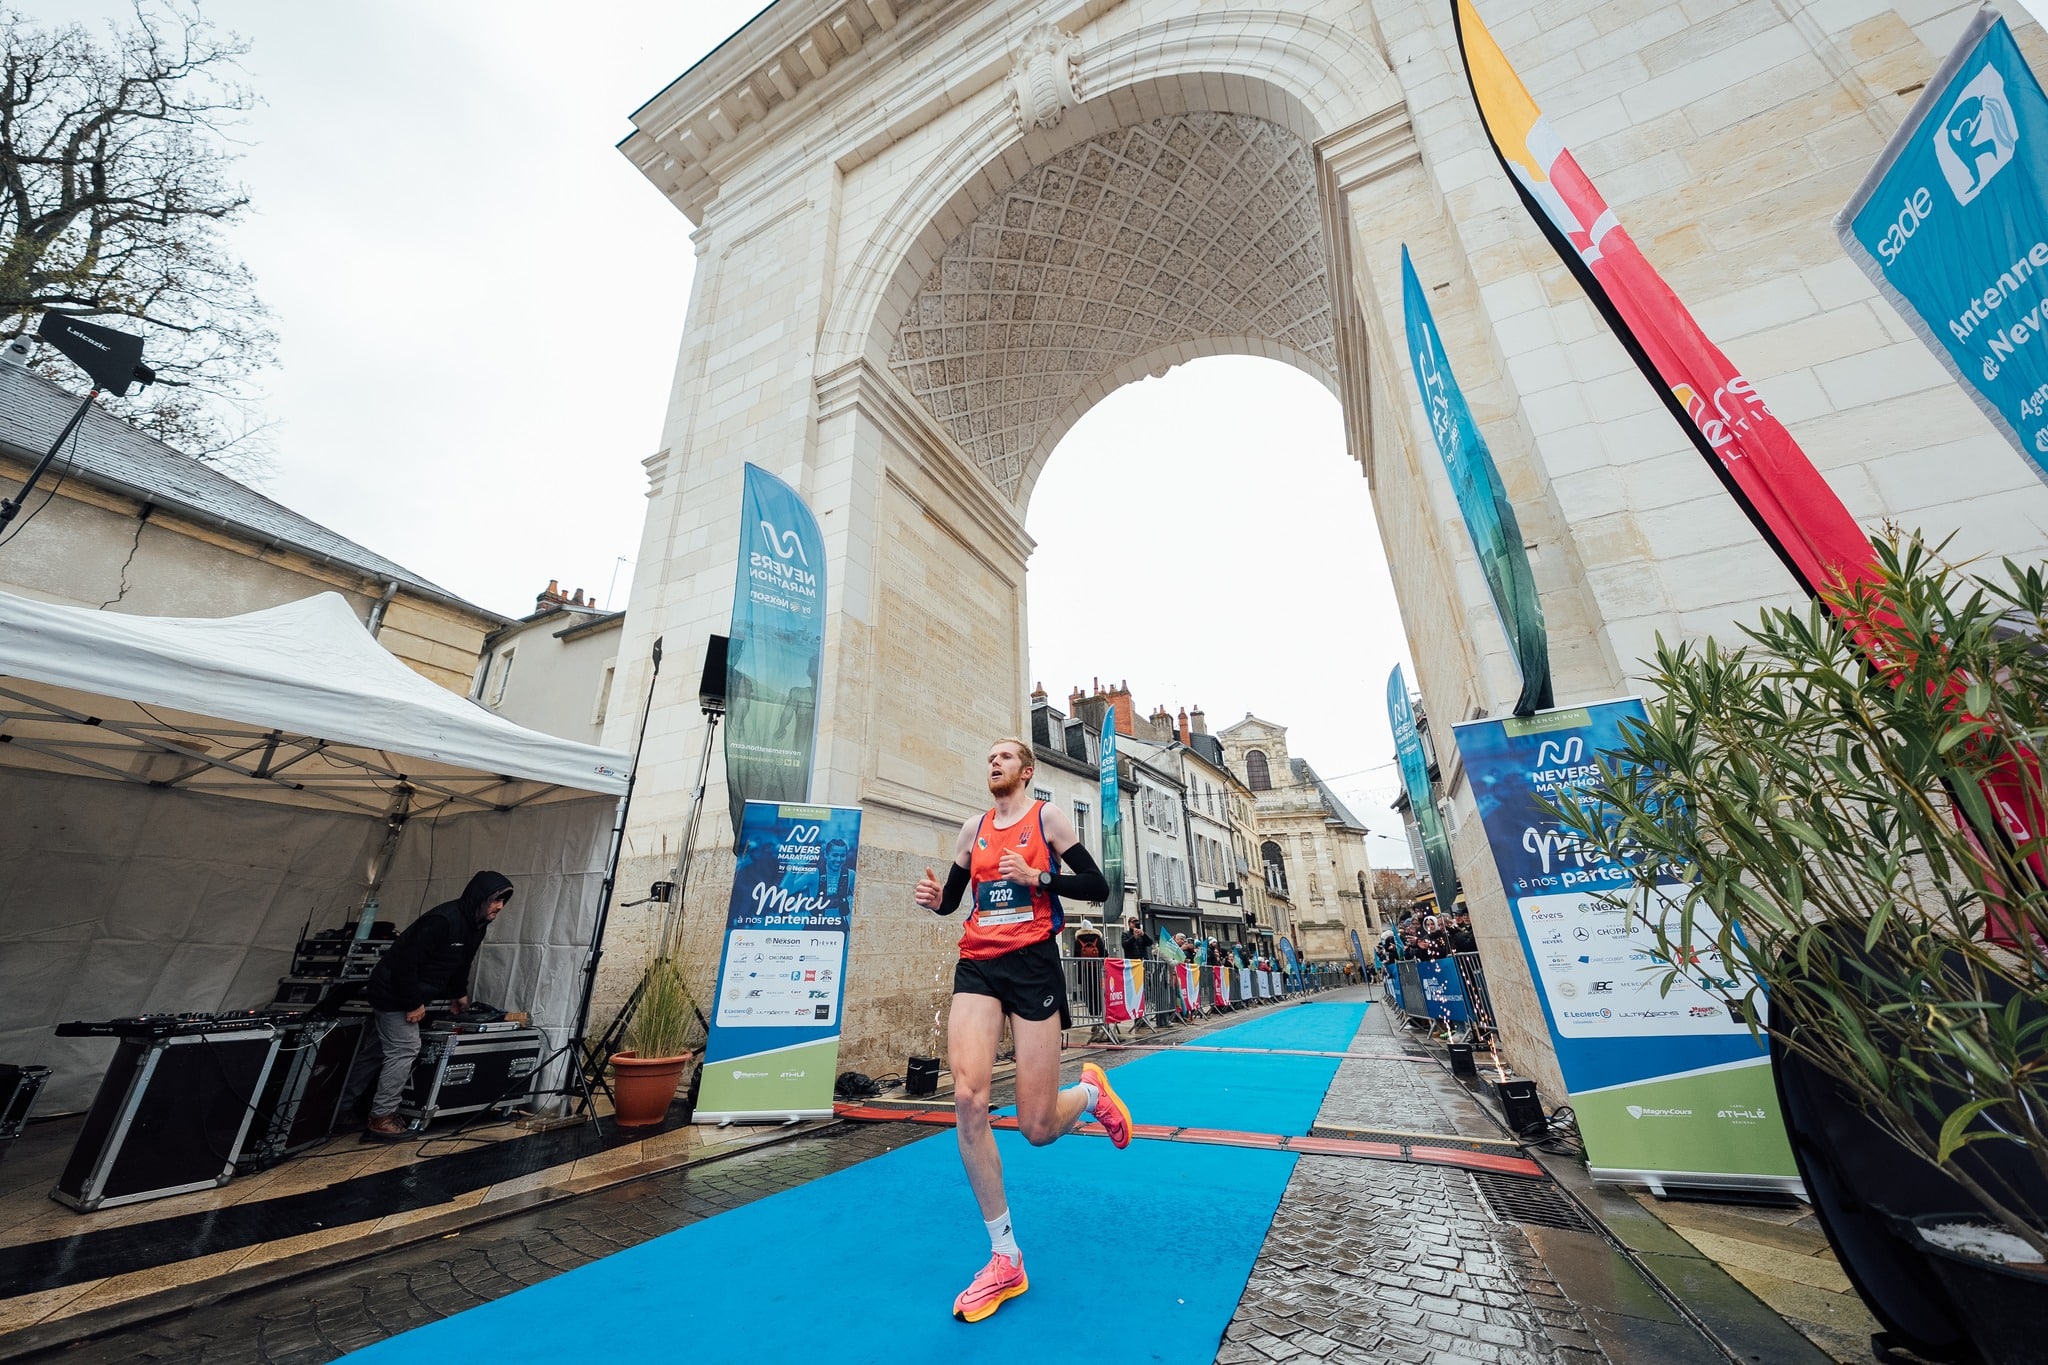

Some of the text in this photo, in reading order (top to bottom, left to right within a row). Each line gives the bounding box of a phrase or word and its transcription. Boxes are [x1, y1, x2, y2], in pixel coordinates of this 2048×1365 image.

[1877, 186, 1933, 266] sade
[1949, 242, 2048, 344] Antenne
[1526, 717, 1560, 725] FRENCH
[1532, 764, 1600, 783] NEVERS
[778, 845, 821, 854] NEVERS
[778, 853, 820, 861] MARATHON
[1518, 877, 1528, 888] à
[1531, 876, 1558, 887] nos
[752, 881, 830, 915] Merci
[989, 888, 1013, 902] 2232
[737, 915, 743, 924] à
[764, 914, 842, 926] partenaires
[1531, 912, 1563, 920] nevers
[772, 937, 800, 945] Nexson
